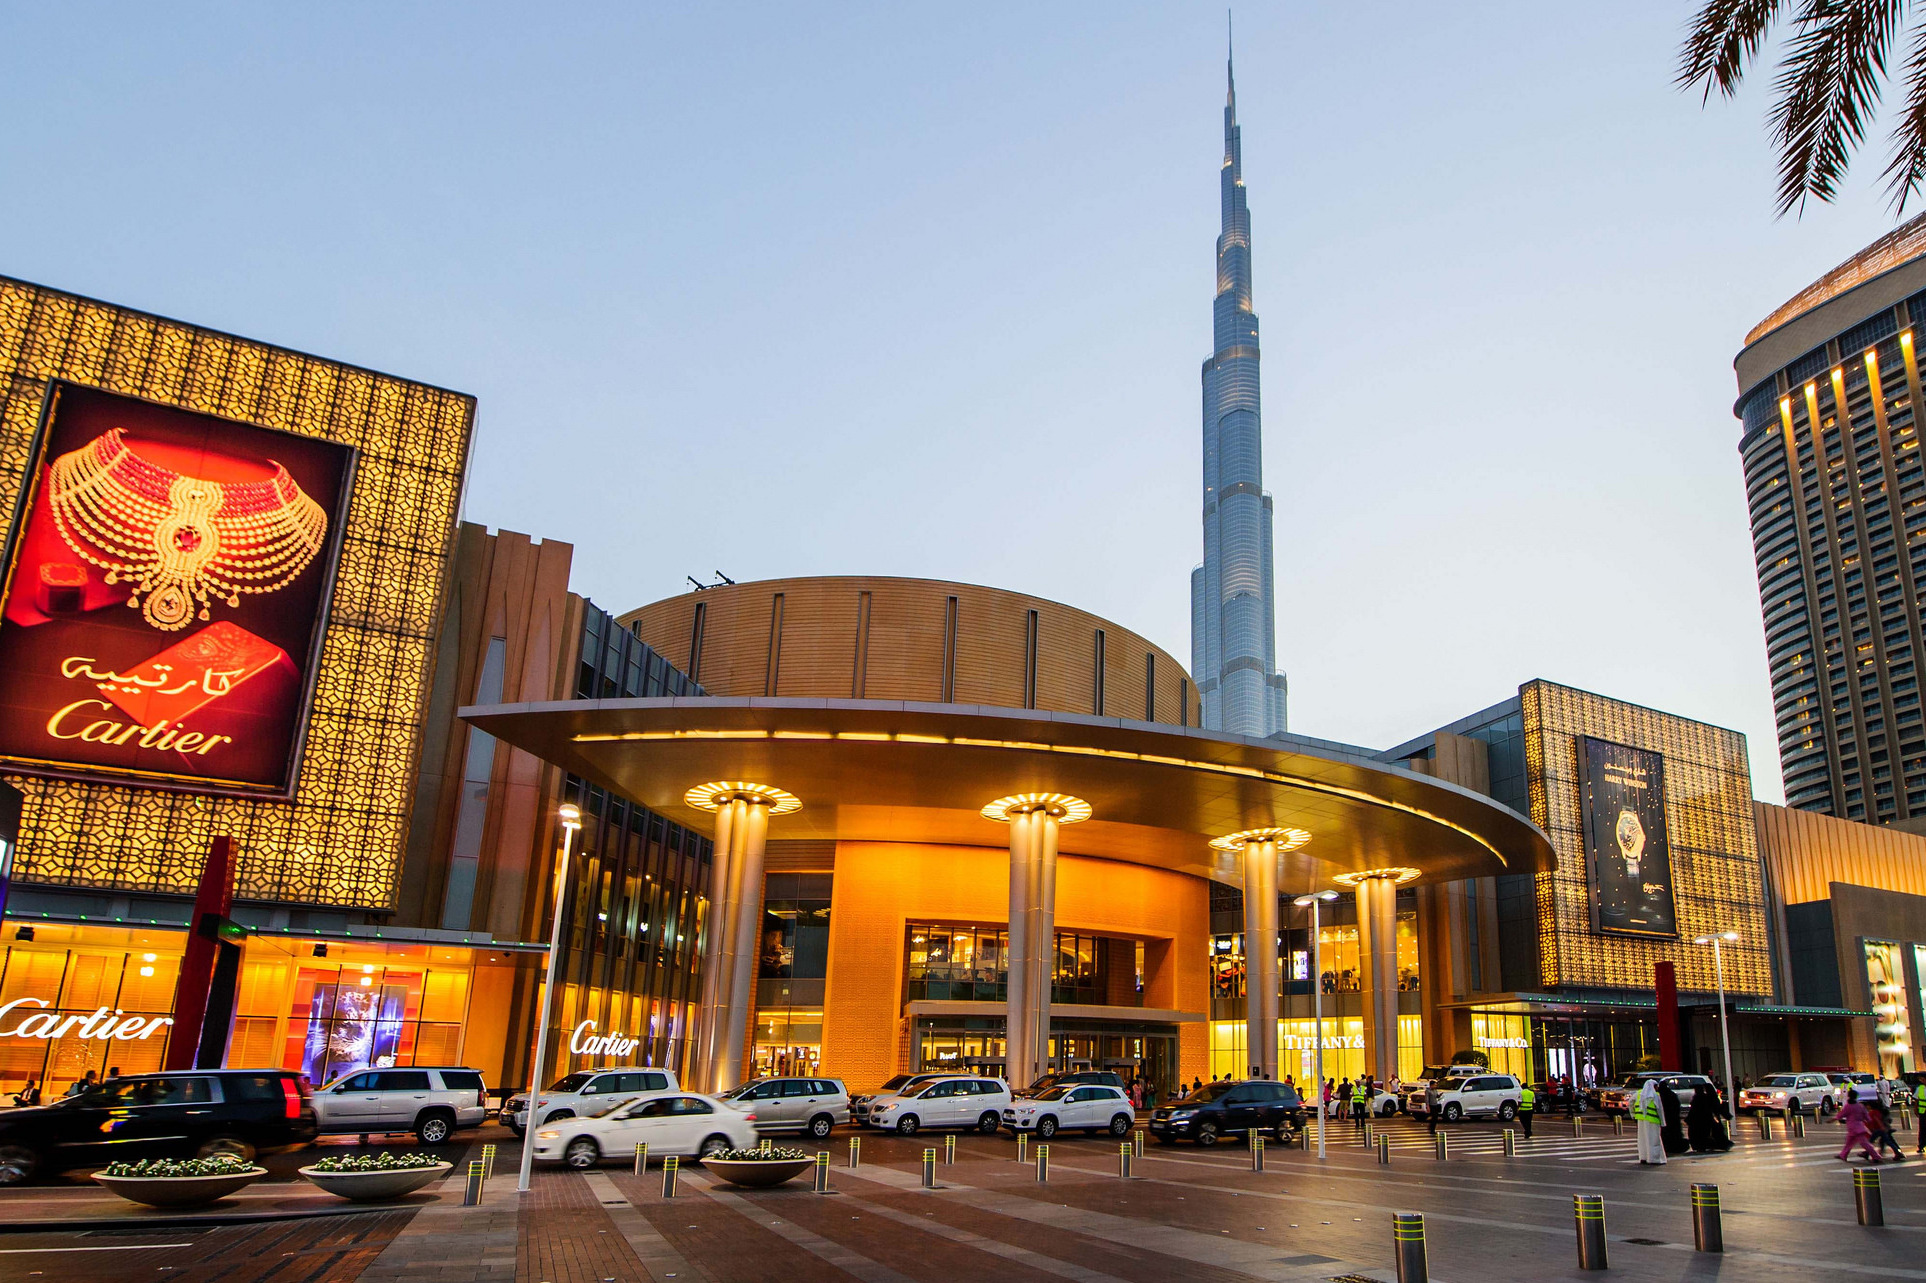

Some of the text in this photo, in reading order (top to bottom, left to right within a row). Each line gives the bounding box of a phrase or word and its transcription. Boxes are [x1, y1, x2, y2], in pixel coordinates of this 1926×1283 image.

[61, 656, 246, 696] كارتييه
[46, 699, 232, 755] Cartier
[0, 997, 174, 1040] Cartier
[570, 1019, 639, 1056] Cartier
